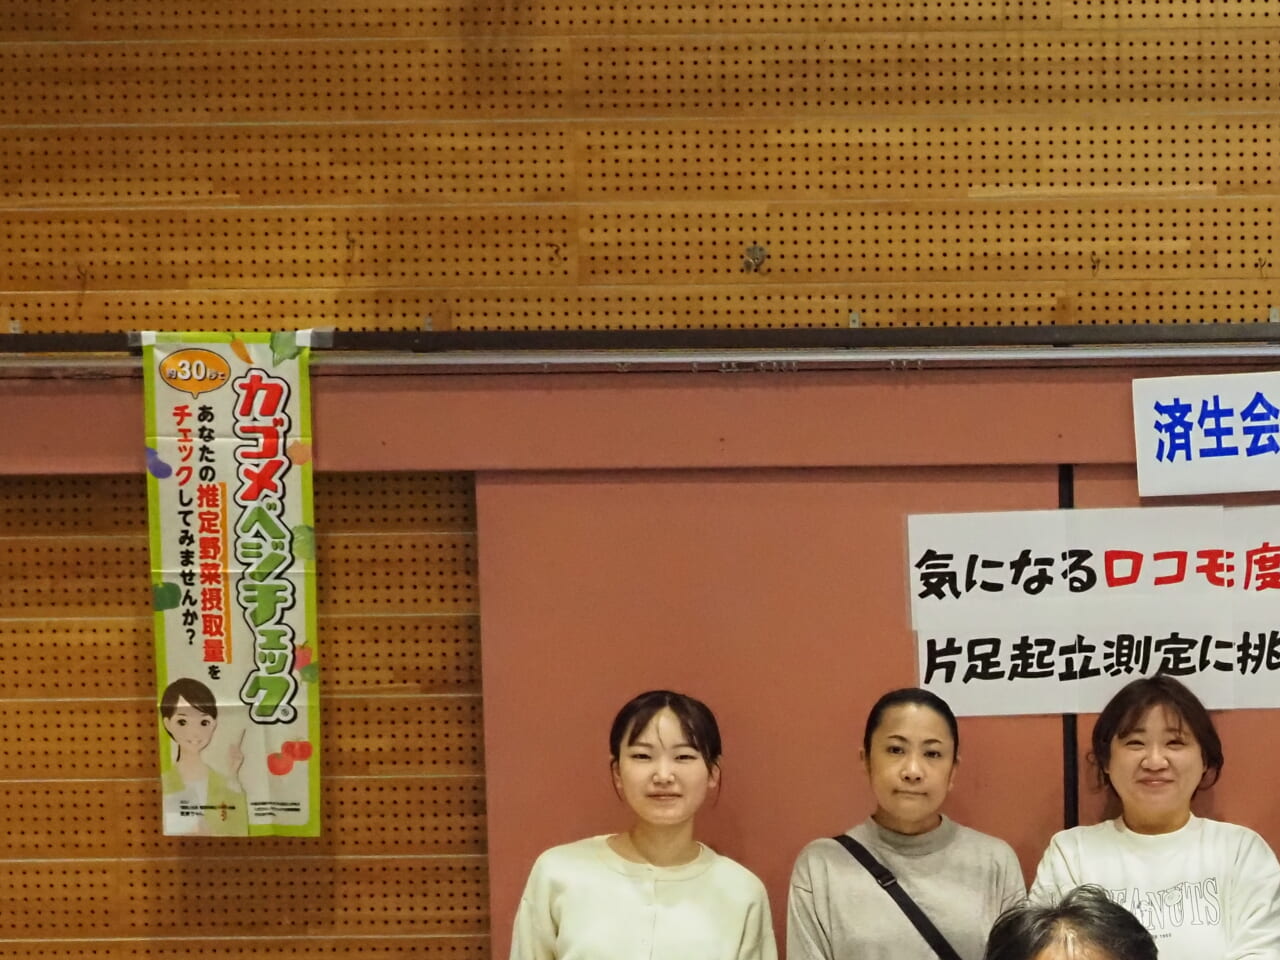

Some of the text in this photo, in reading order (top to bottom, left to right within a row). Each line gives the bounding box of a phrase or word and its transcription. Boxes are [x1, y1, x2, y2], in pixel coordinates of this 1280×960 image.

[172, 404, 199, 646] チェックしてみませんか？
[196, 405, 225, 680] あなたの推定野菜摂取量を
